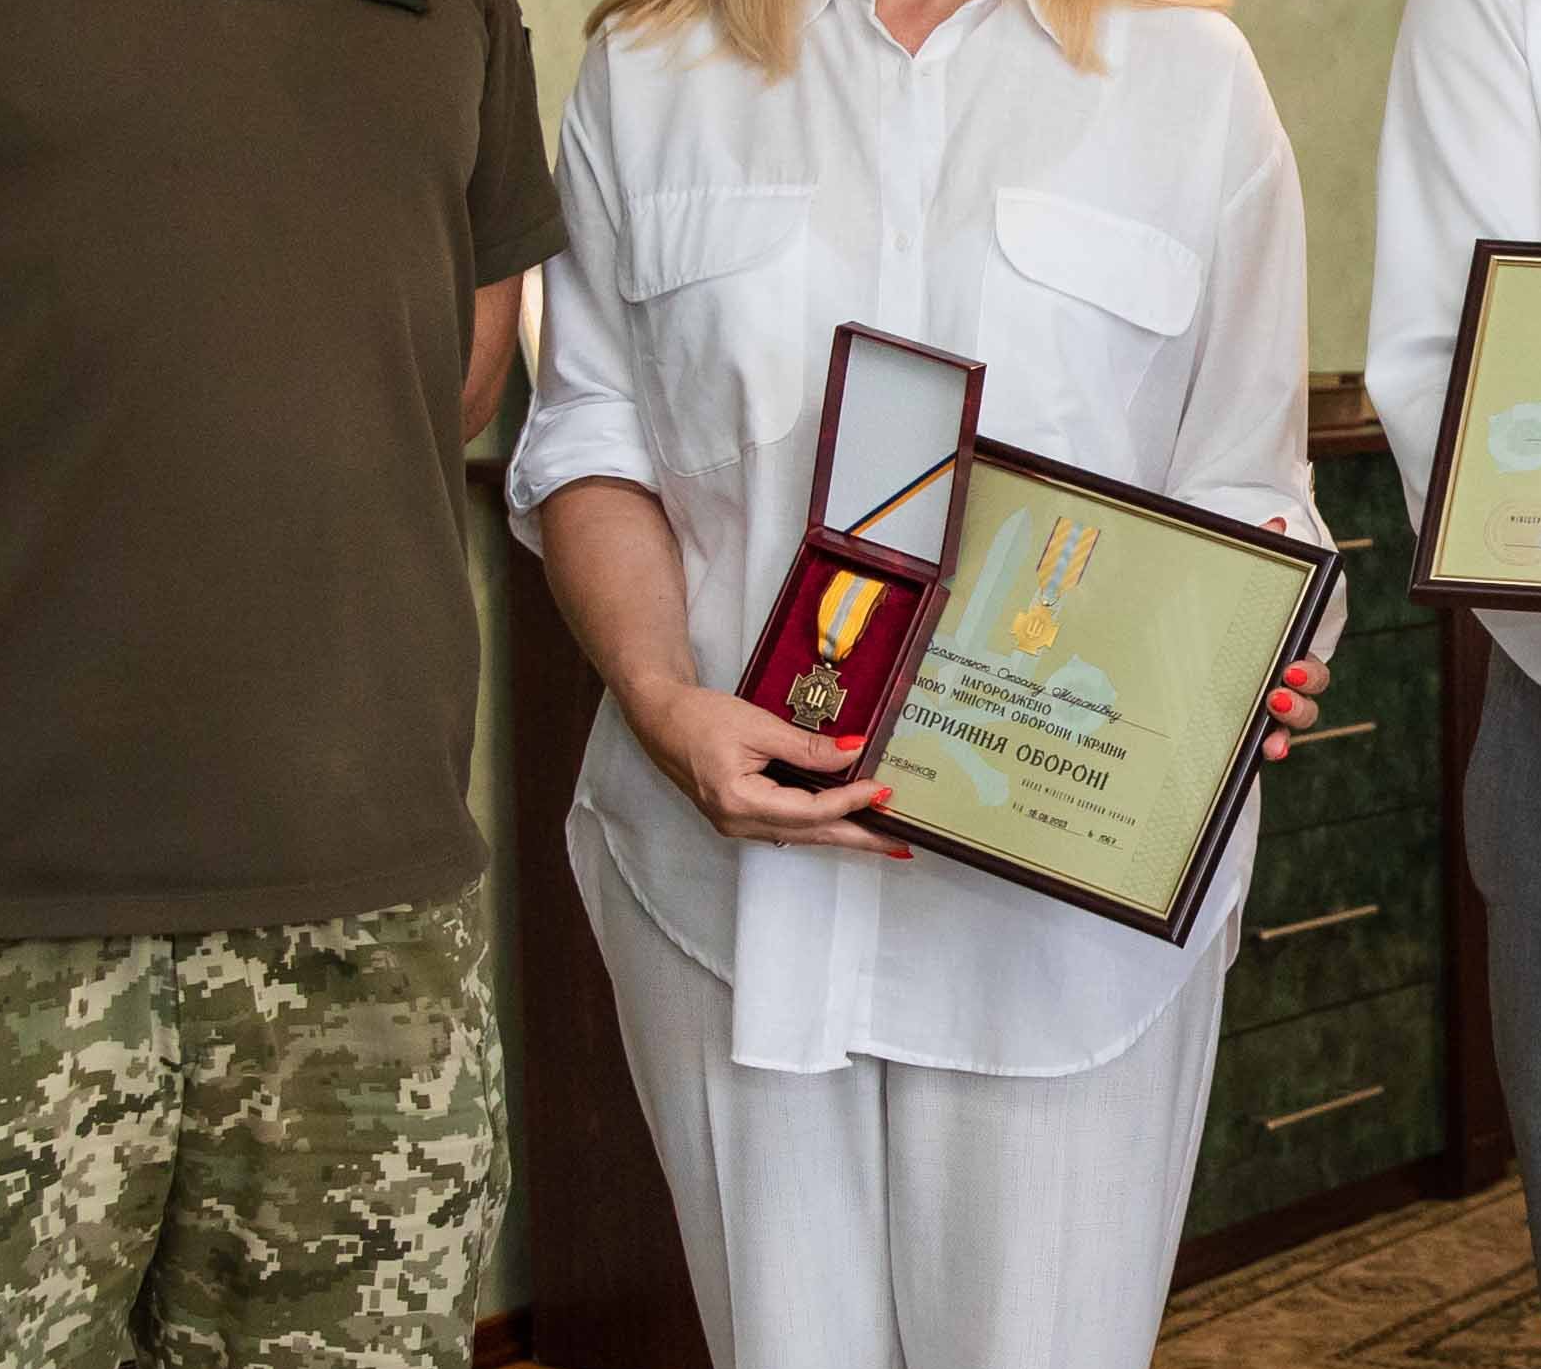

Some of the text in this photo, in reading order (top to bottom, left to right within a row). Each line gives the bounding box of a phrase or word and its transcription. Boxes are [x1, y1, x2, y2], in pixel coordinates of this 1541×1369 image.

[914, 675, 1127, 760] КОЮ МІНІСТРА ОБОРОНИ УКРАЇНИ
[961, 674, 1052, 716] НАГОРОДЖЕНО
[902, 703, 1109, 791] СПРИЯННЯ ОБОРОНІ
